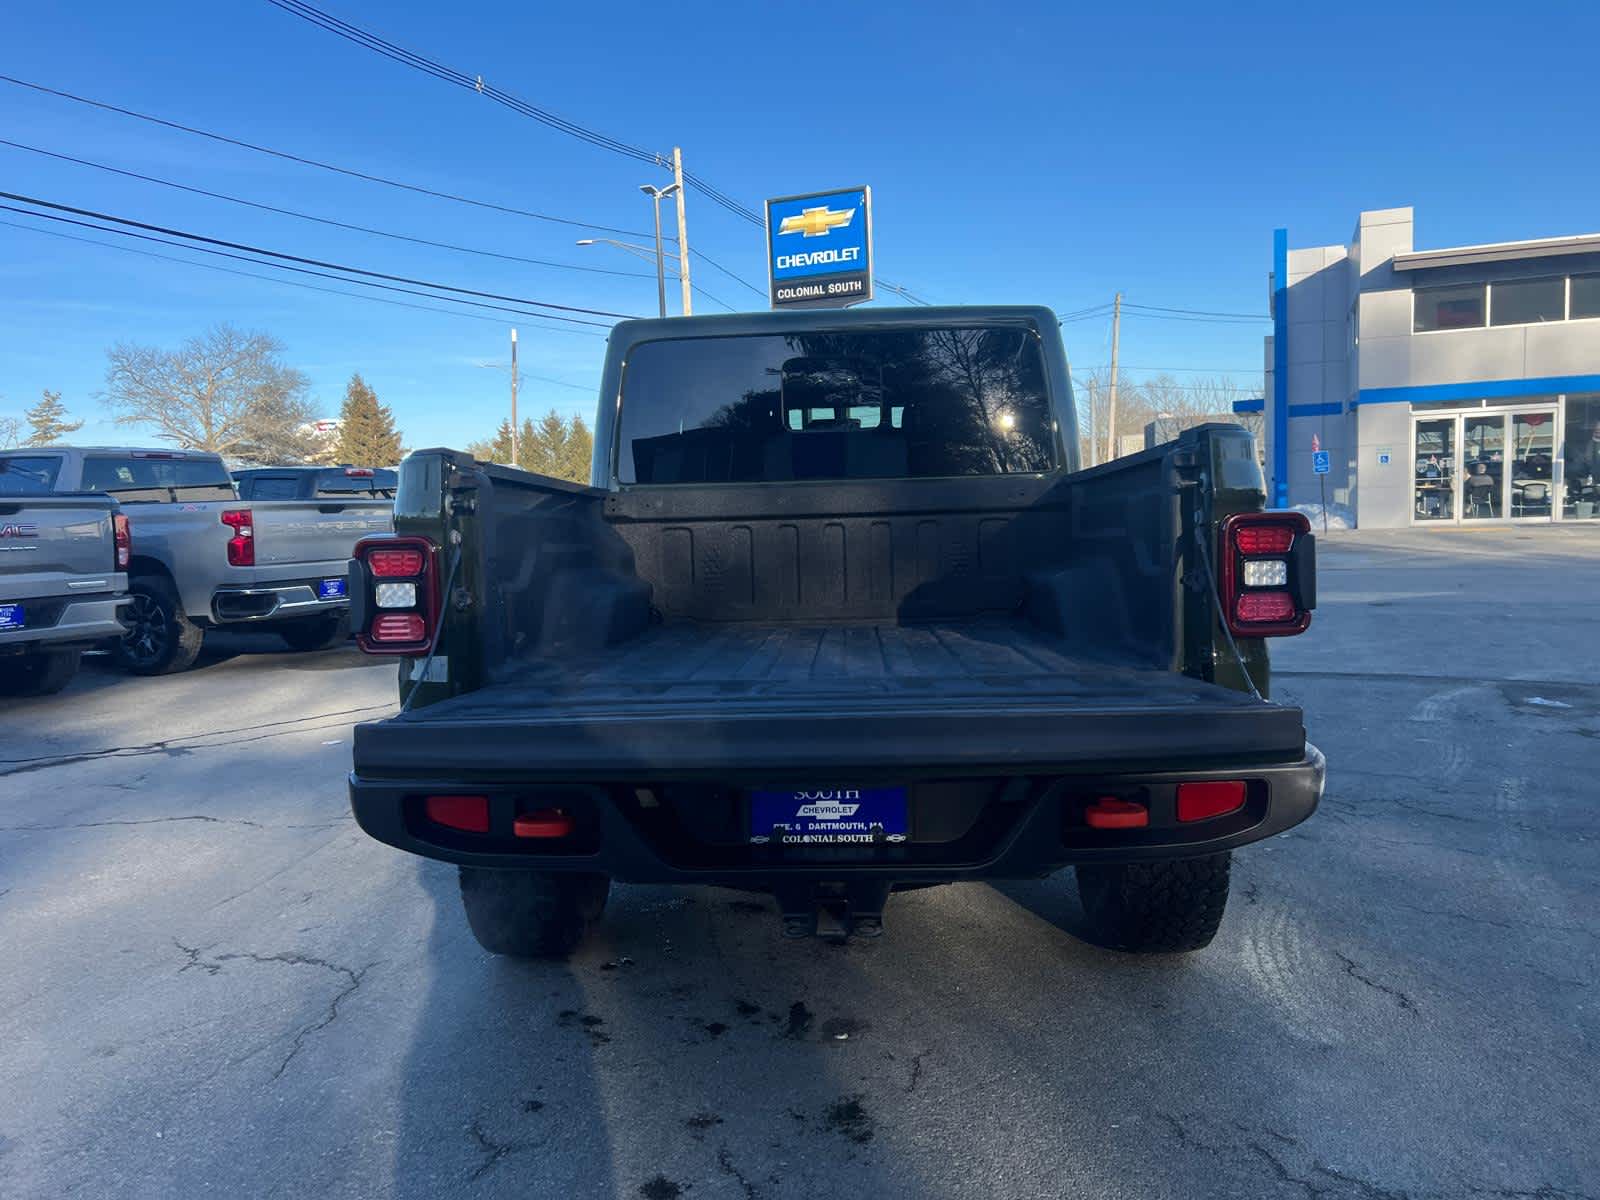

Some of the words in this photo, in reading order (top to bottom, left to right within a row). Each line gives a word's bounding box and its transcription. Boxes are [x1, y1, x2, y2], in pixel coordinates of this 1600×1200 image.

[777, 247, 860, 269] CHEVROLET
[777, 286, 825, 299] COLONIAL
[828, 281, 862, 293] SOUTH
[0, 524, 39, 538] MC
[802, 806, 853, 814] CHEVROLET
[808, 822, 867, 831] DARTMOUTH,
[782, 834, 836, 844] COLNIAL
[837, 833, 874, 843] SOUTH
